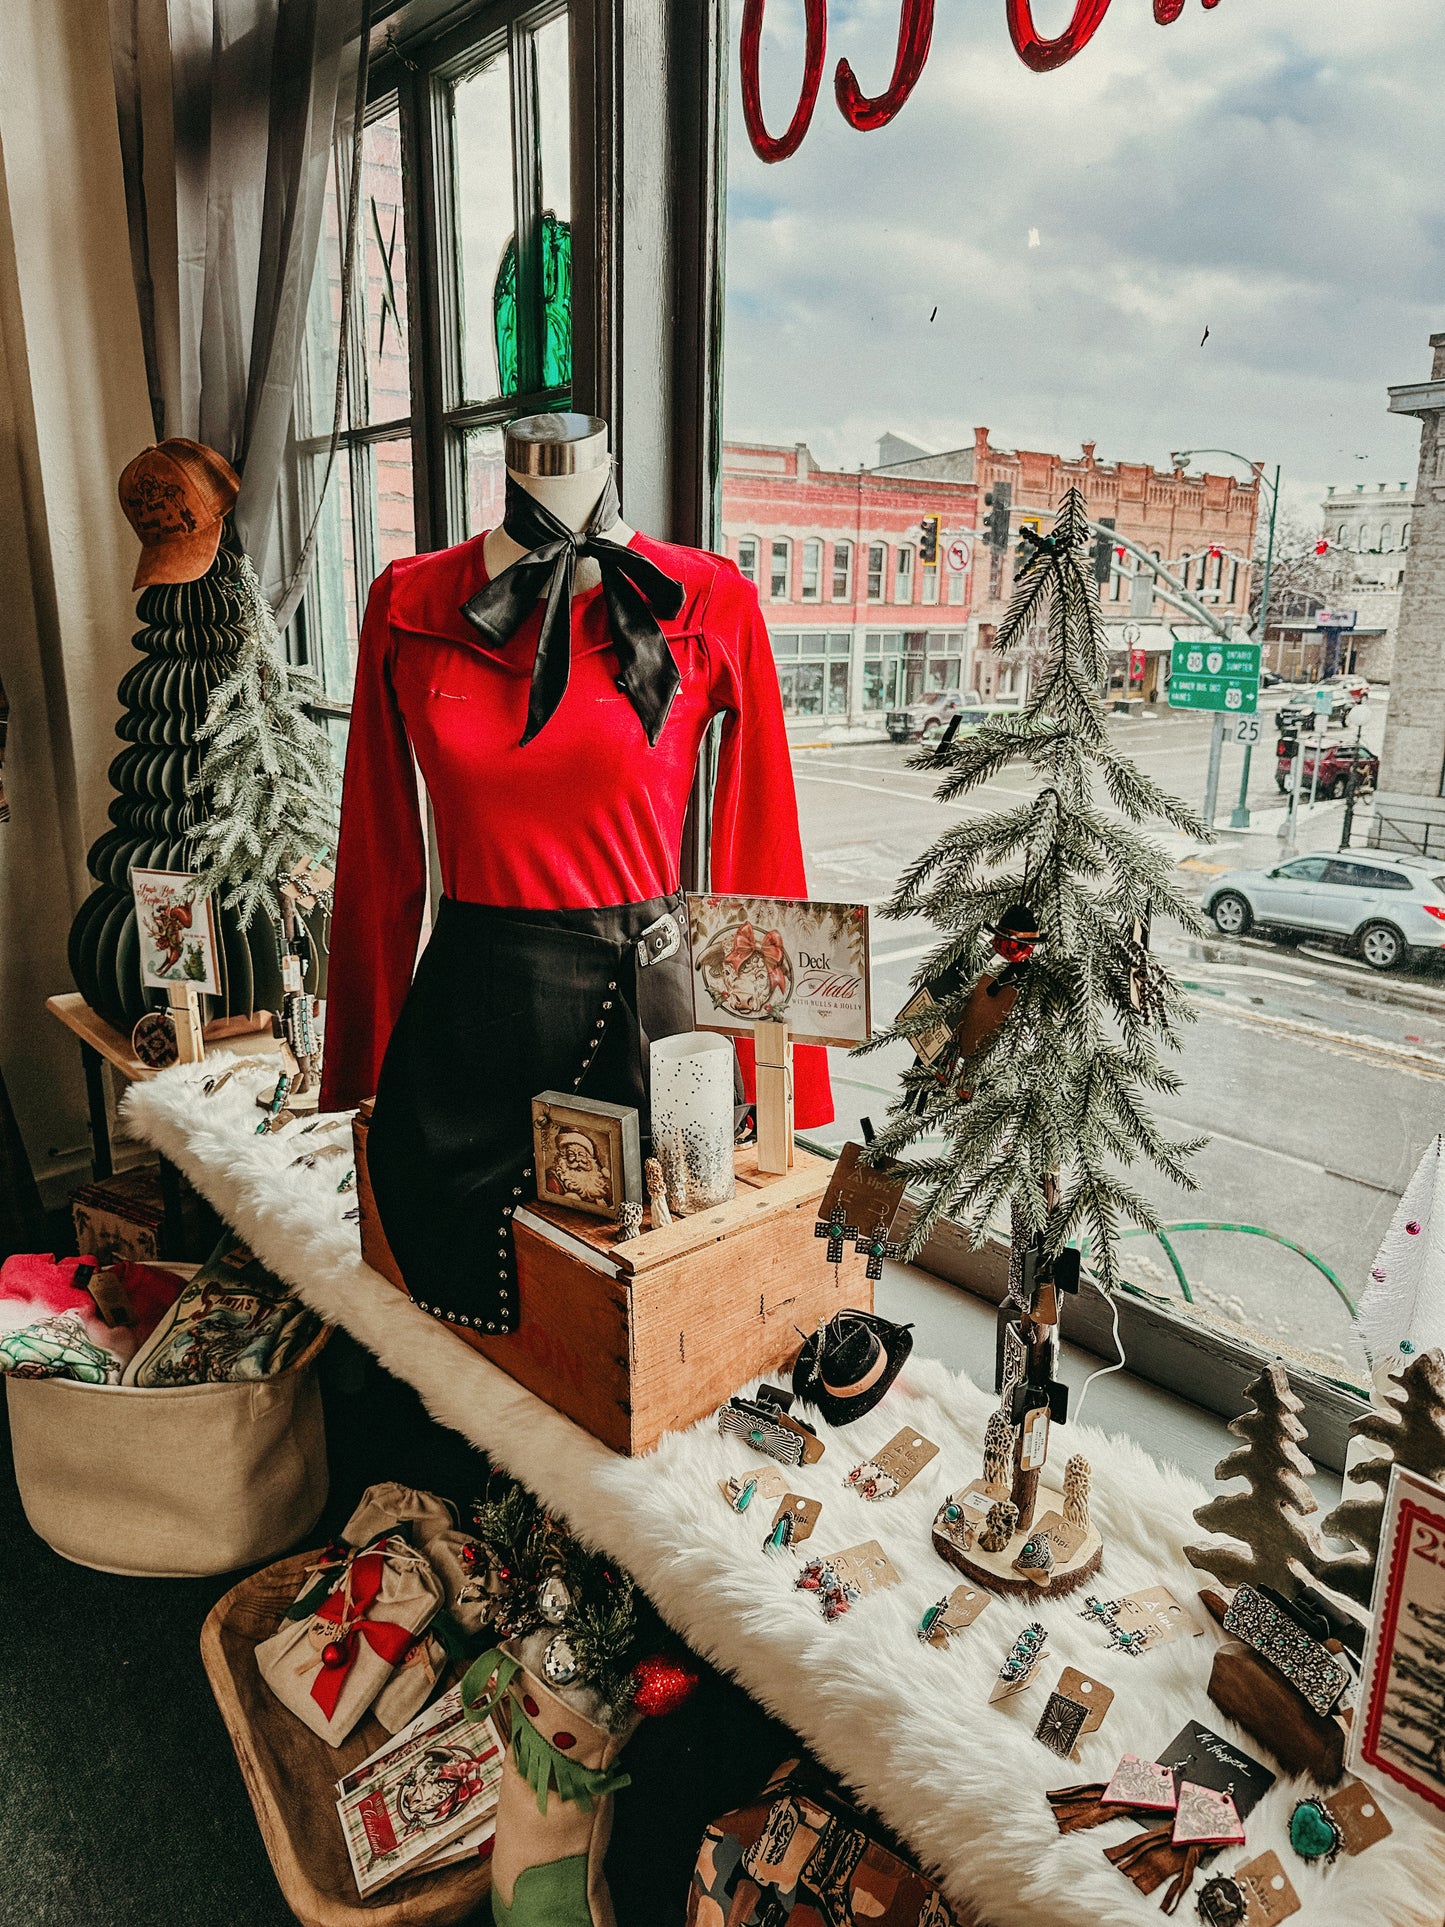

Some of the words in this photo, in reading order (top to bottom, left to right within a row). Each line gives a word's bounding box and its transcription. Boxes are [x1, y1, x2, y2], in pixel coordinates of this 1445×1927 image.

[1189, 656, 1201, 668] 30
[1226, 651, 1253, 660] ONTARIO
[1226, 662, 1253, 672] SUMPTER
[1227, 692, 1240, 704] 30
[1237, 720, 1259, 741] 25
[798, 951, 831, 970] Deck
[795, 969, 862, 999] Halls
[791, 998, 808, 1006] WITH
[810, 1000, 831, 1008] BULLS
[793, 1514, 809, 1524] tipi
[1052, 1537, 1070, 1549] tipi
[1413, 1527, 1445, 1569] 2
[1196, 1733, 1215, 1747] M.
[374, 1794, 387, 1818] MERRY
[361, 1797, 382, 1855] Christmas
